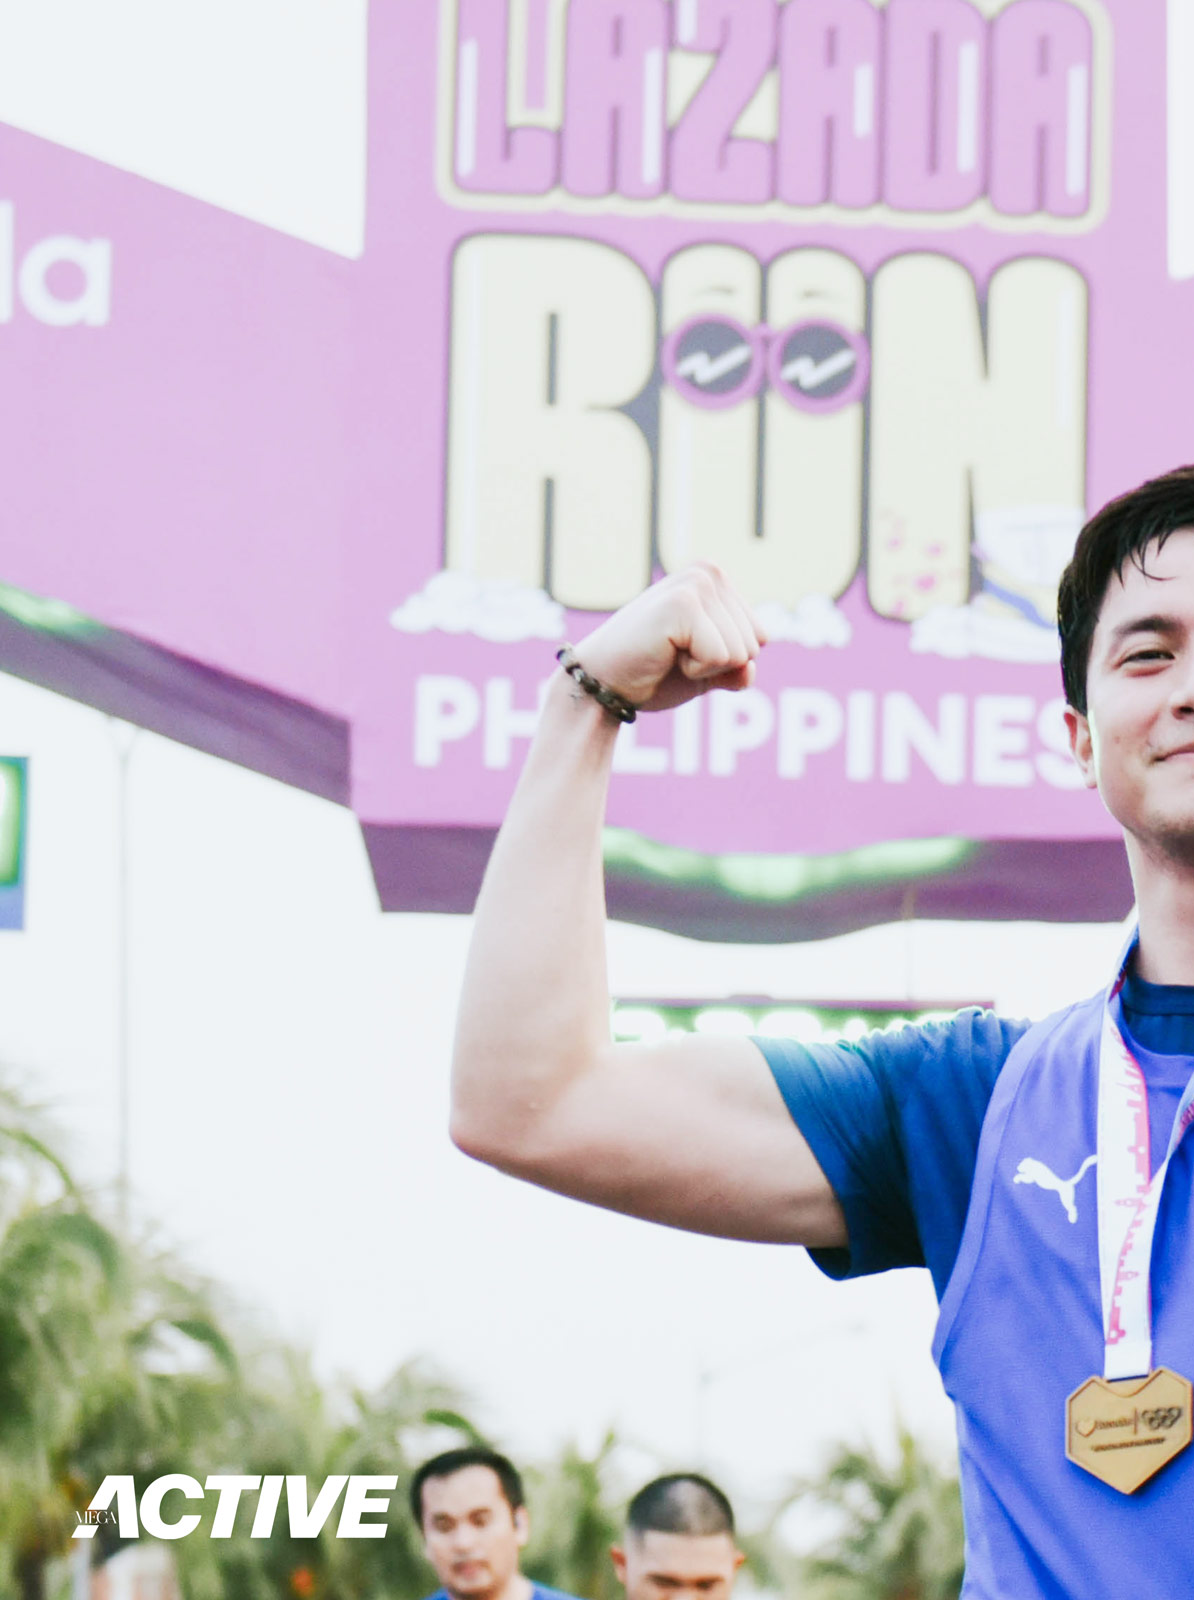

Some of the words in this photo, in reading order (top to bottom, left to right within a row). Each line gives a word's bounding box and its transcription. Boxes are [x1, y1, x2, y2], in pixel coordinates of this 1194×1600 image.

[450, 0, 1095, 220] LAZADA
[442, 231, 1092, 624] RUN
[411, 673, 1085, 791] PHLIPPINES
